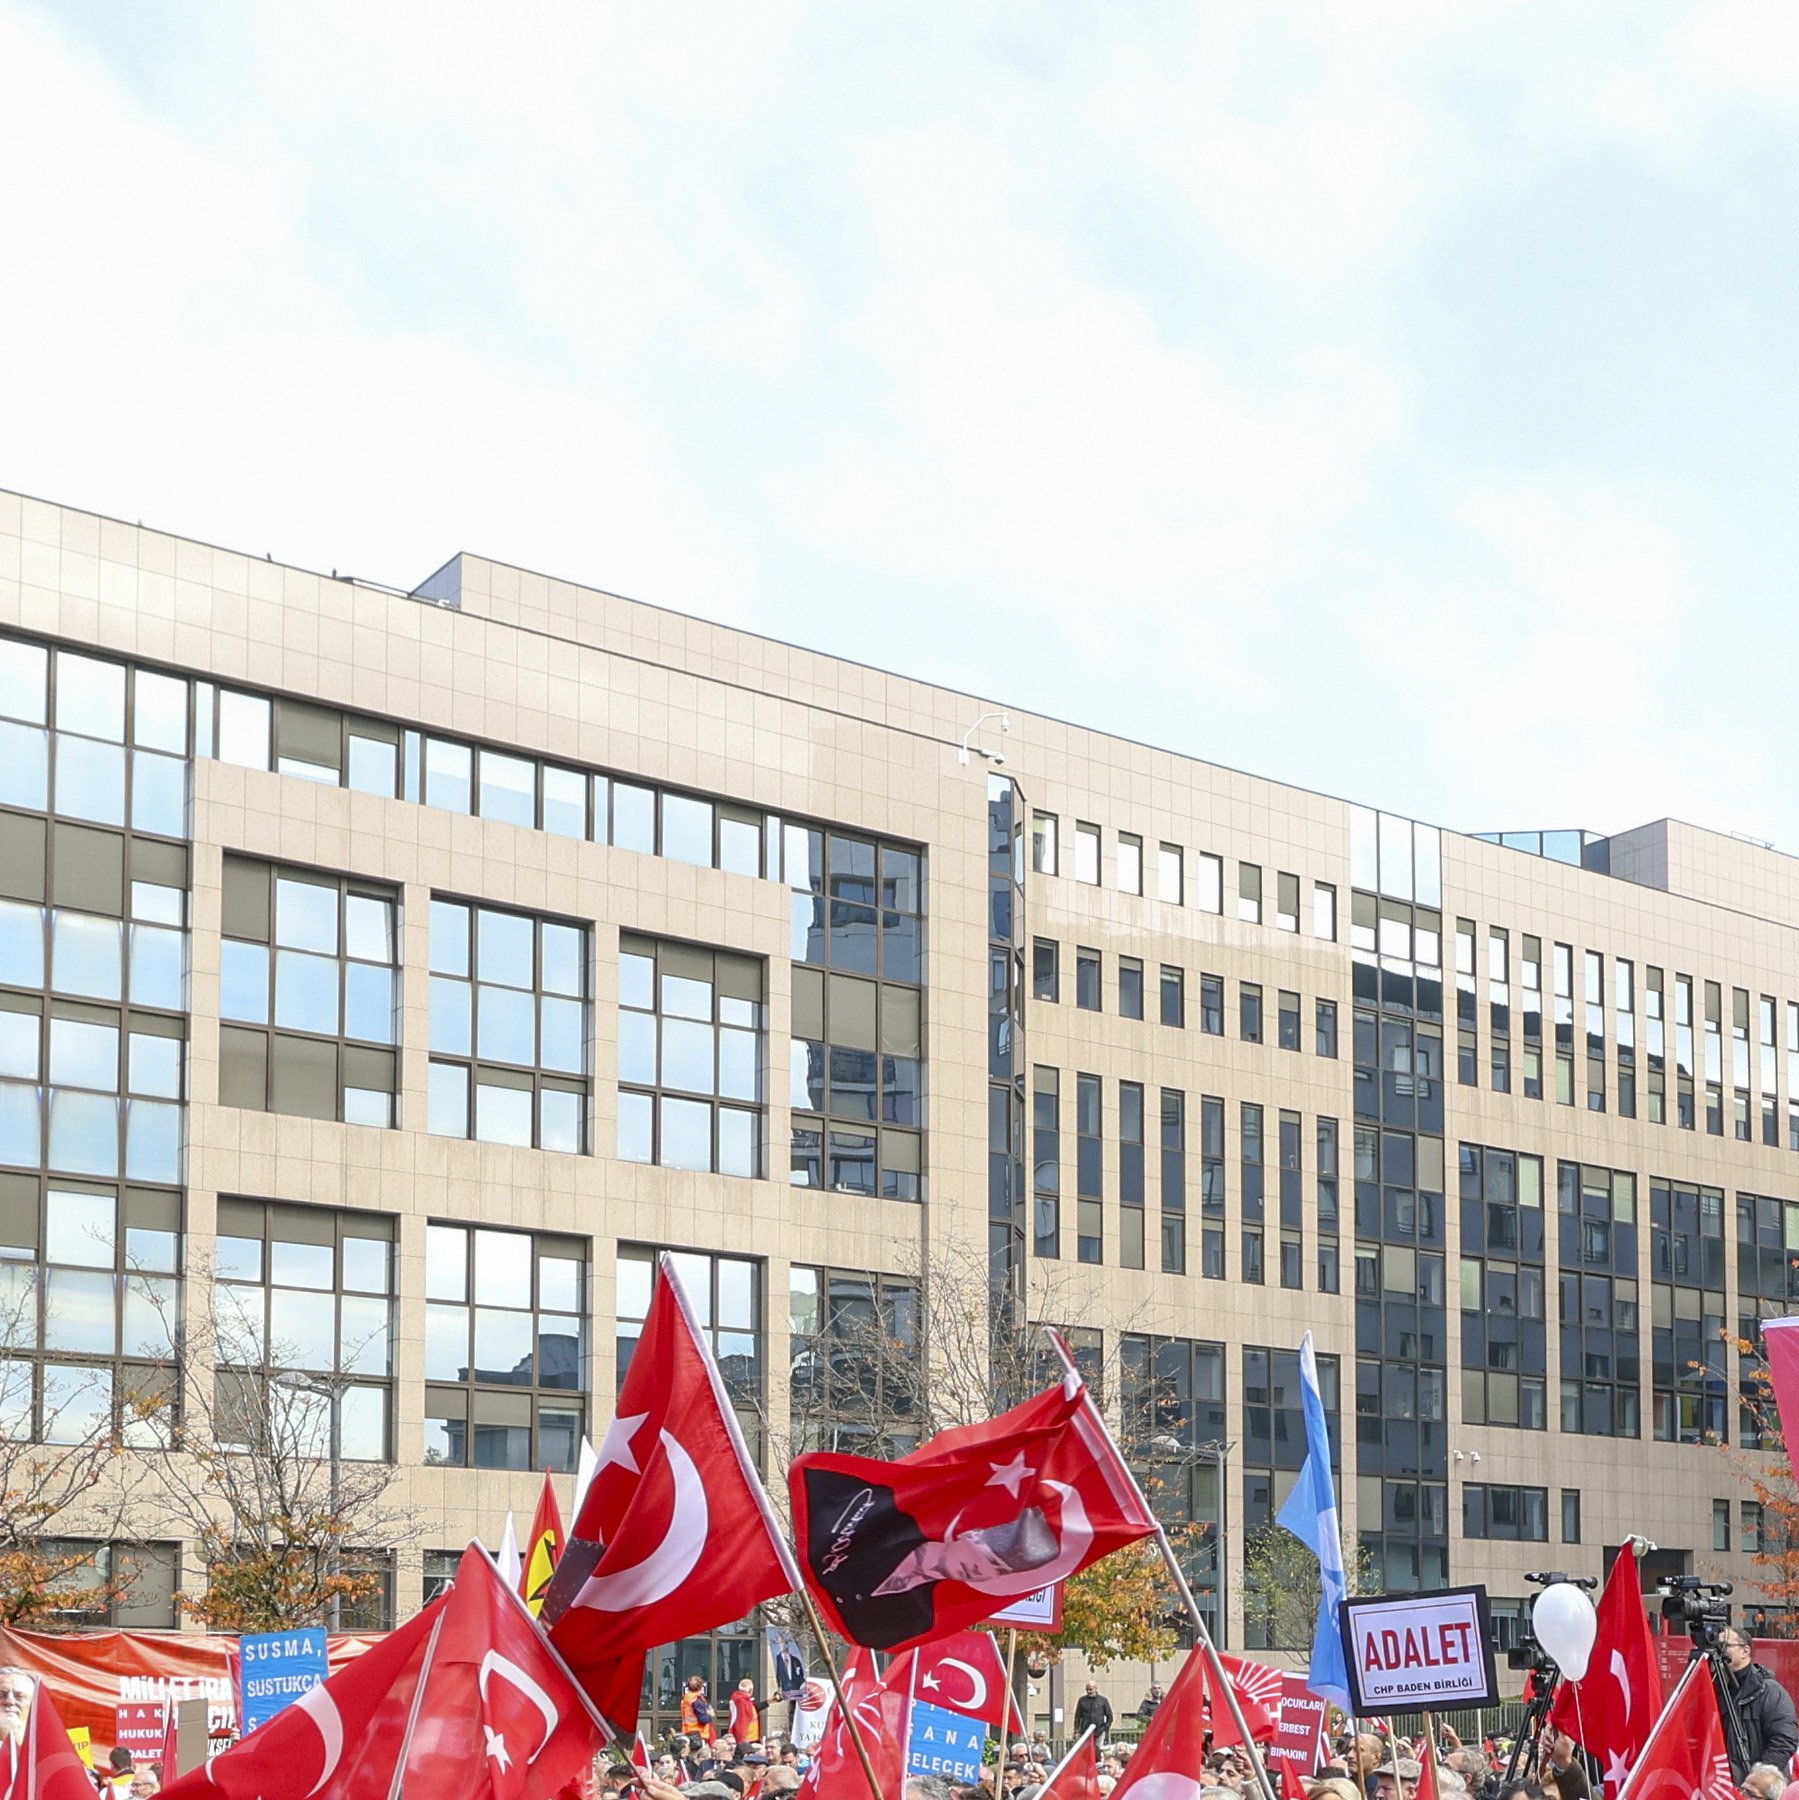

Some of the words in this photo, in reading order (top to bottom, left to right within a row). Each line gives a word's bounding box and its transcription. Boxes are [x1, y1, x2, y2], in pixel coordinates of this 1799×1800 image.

[245, 1637, 322, 1662] SUSMA,
[1364, 1621, 1472, 1673] ADALET
[1373, 1685, 1394, 1695] CHP
[1397, 1682, 1431, 1693] BADEN
[1282, 1697, 1324, 1711] OCUKLARI
[119, 1728, 163, 1739] HUKUK
[1279, 1722, 1311, 1736] ERBEST
[130, 1749, 164, 1759] DALET
